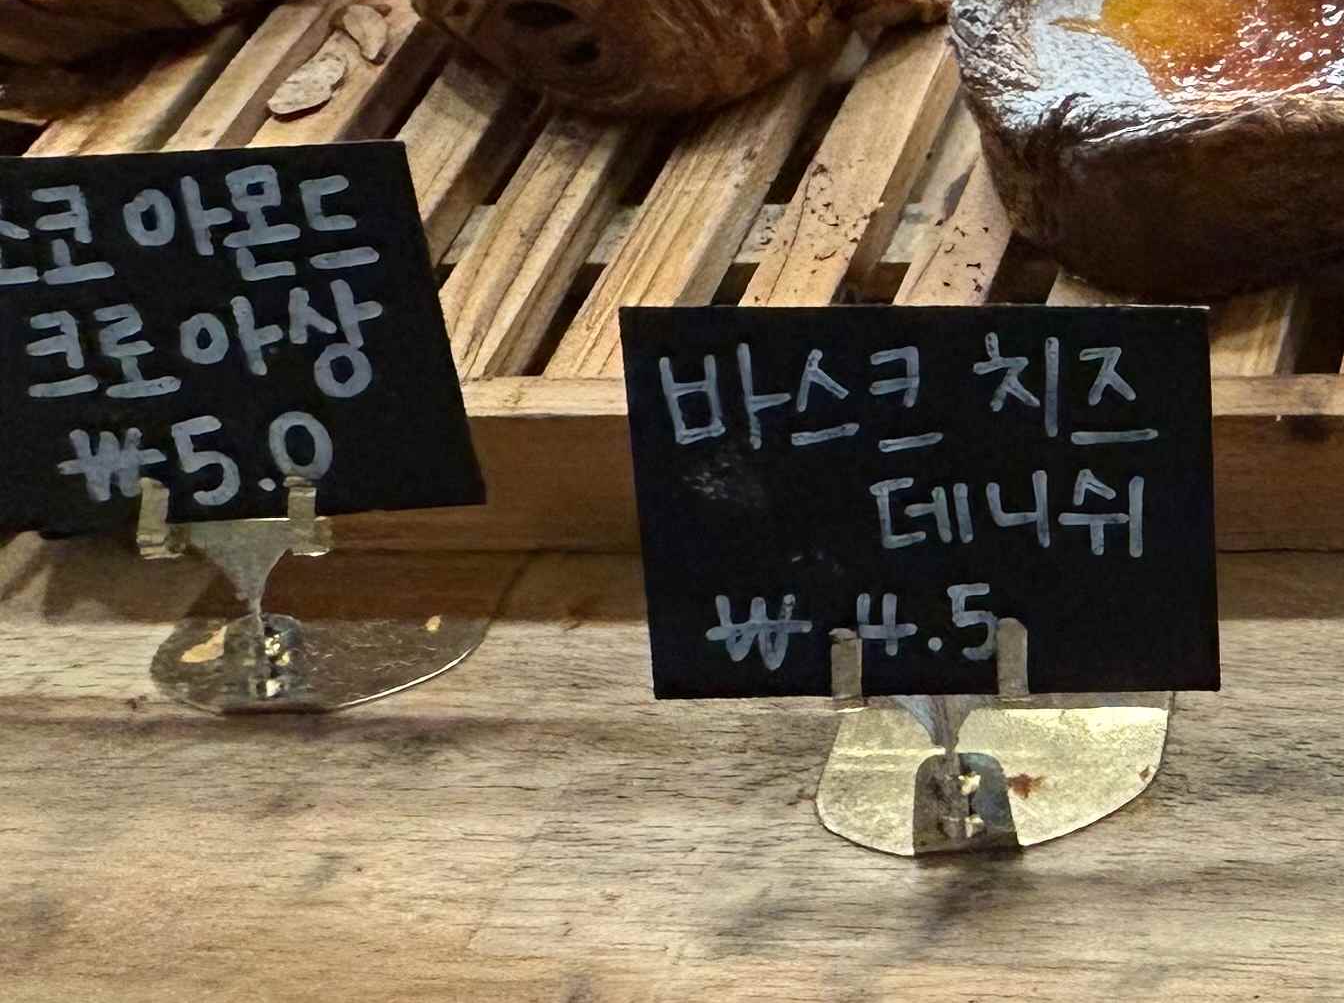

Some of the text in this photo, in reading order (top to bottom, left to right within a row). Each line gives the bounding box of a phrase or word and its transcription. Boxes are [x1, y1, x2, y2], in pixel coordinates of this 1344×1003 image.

[26, 279, 383, 398] 크로아상
[659, 332, 1159, 452] 바스크 치즈
[869, 469, 1144, 558] 데니쉬
